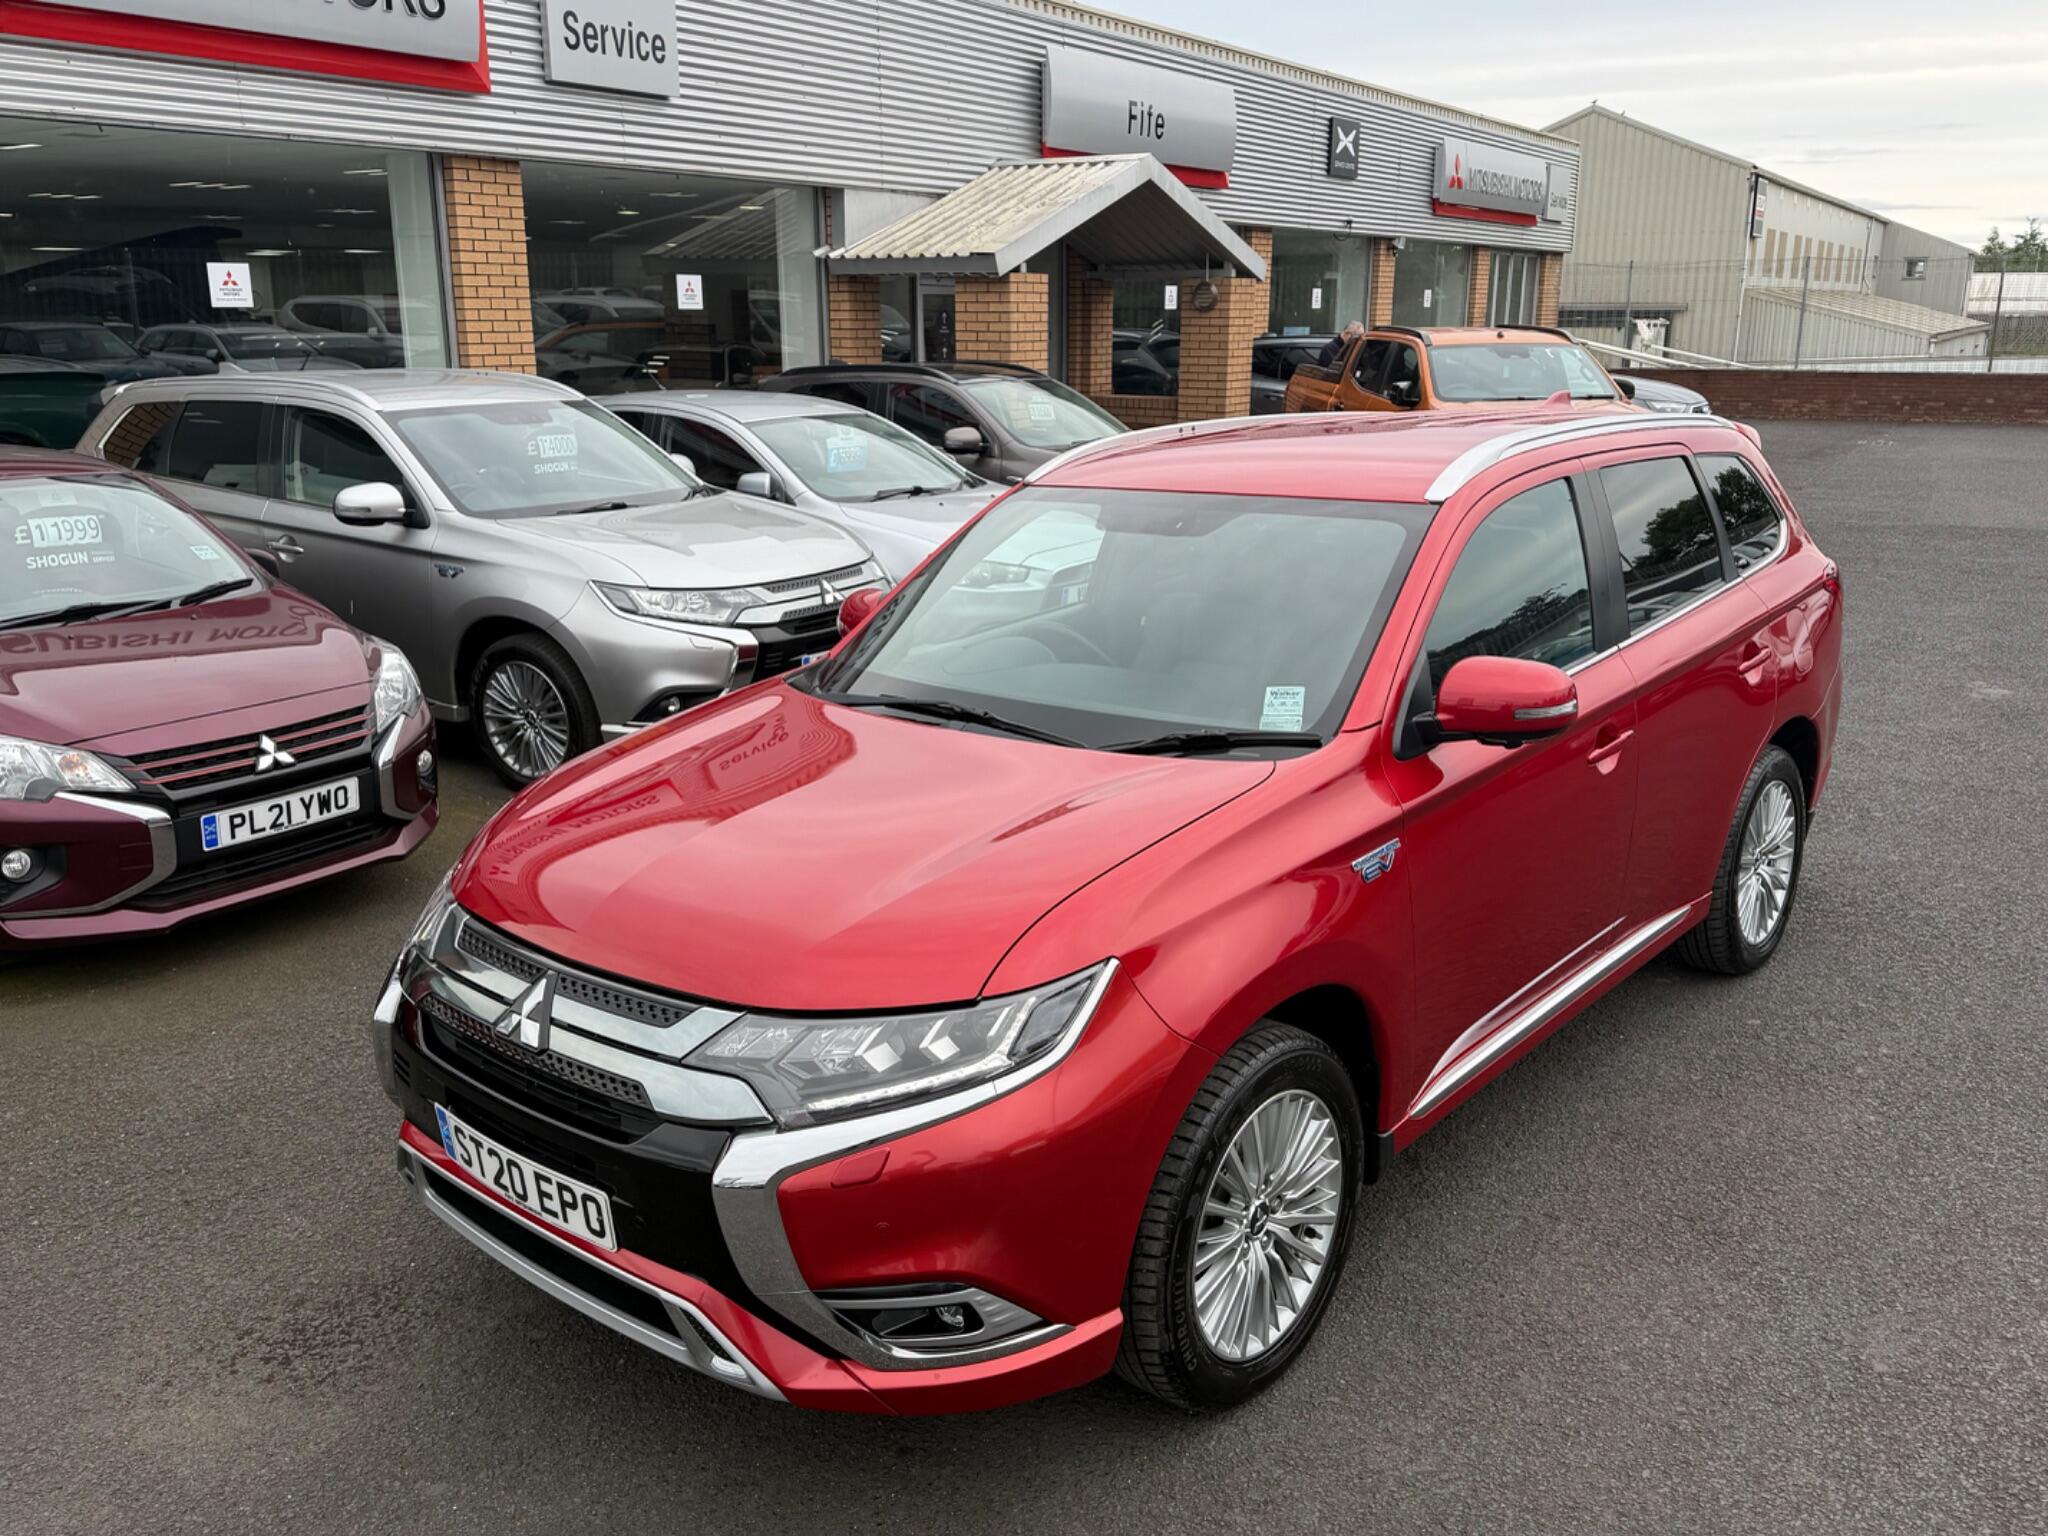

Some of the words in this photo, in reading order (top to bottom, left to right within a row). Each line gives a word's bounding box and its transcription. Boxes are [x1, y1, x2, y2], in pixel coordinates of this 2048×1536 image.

[563, 10, 666, 63] Service
[1128, 100, 1165, 140] Fife
[26, 552, 88, 569] SHOGUN
[229, 800, 292, 840] PL21
[300, 785, 349, 820] YWO
[454, 1124, 529, 1203] ST20
[533, 1170, 606, 1239] EPO
